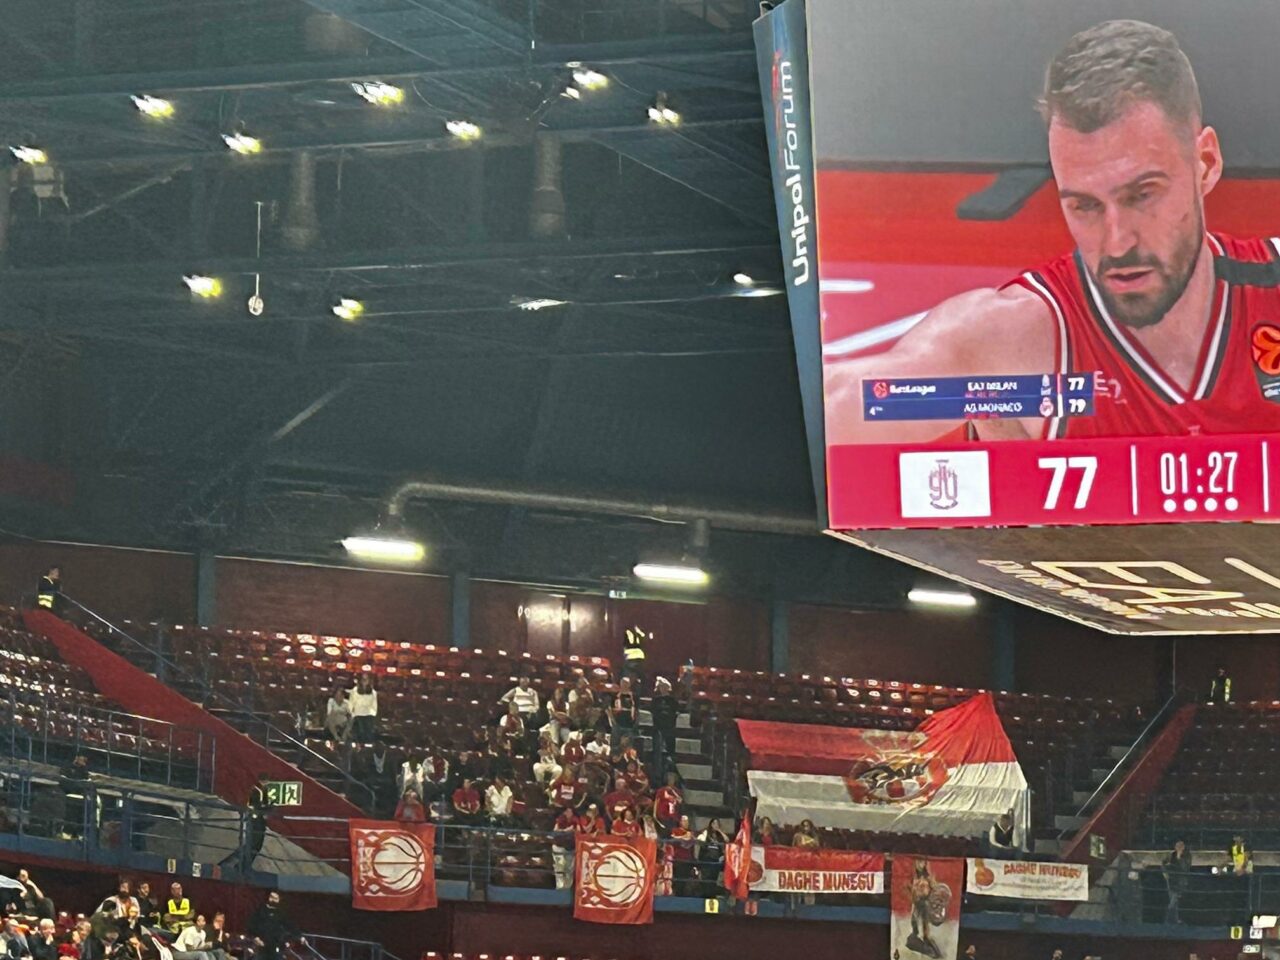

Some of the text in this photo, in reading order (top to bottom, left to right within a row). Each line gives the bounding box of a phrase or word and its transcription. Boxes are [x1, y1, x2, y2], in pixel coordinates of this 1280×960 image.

[781, 61, 811, 286] UnipolForum
[1067, 377, 1085, 391] 77
[1037, 456, 1098, 510] 77
[1160, 451, 1238, 495] 01:27
[778, 871, 821, 891] DAGHE
